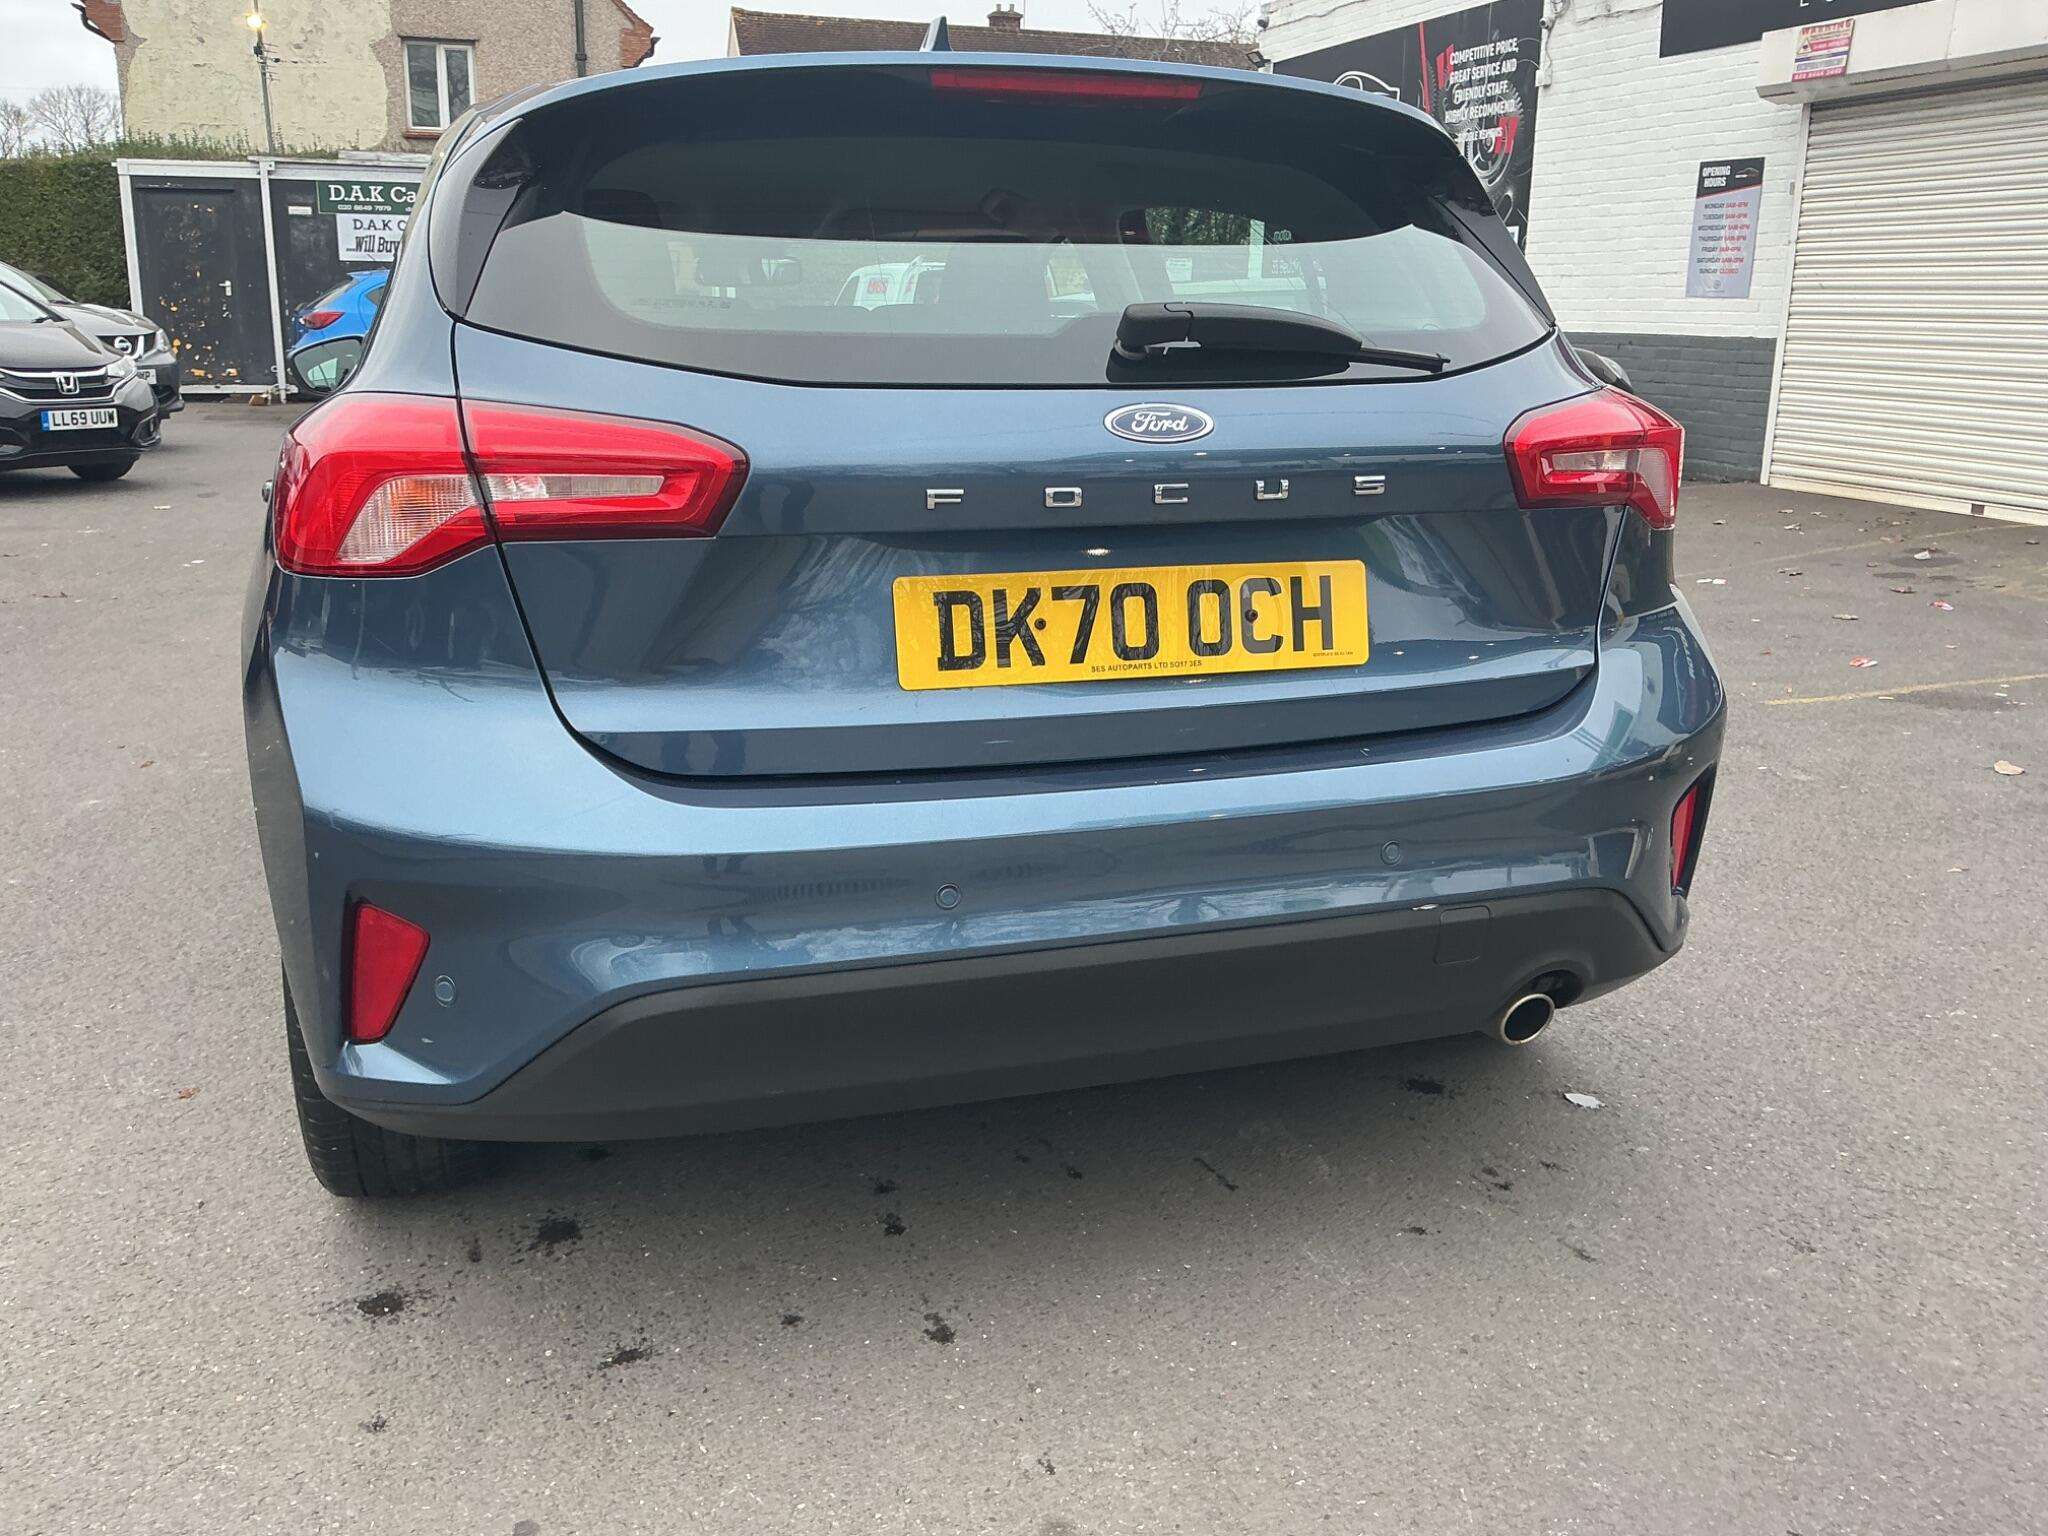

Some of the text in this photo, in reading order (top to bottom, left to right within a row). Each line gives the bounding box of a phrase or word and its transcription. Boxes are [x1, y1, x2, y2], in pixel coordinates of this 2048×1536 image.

[1449, 43, 1495, 65] COMPETITIVE
[1449, 58, 1517, 84] GREAT SERVICE AND
[1454, 85, 1487, 104] FRIENDLY
[1445, 106, 1469, 123] HIGHLY
[1702, 165, 1731, 177] OPENING
[1704, 177, 1727, 188] HOURS
[328, 184, 385, 202] D.A.K
[353, 219, 392, 231] D.A.K
[378, 237, 400, 253] Buy
[52, 412, 87, 427] LL69
[1132, 411, 1188, 433] Ford
[925, 474, 1386, 510] FOCUS
[932, 574, 1334, 672] DK70 OCH
[1107, 661, 1152, 672] AUTOPARTS
[1154, 661, 1168, 669] LTD
